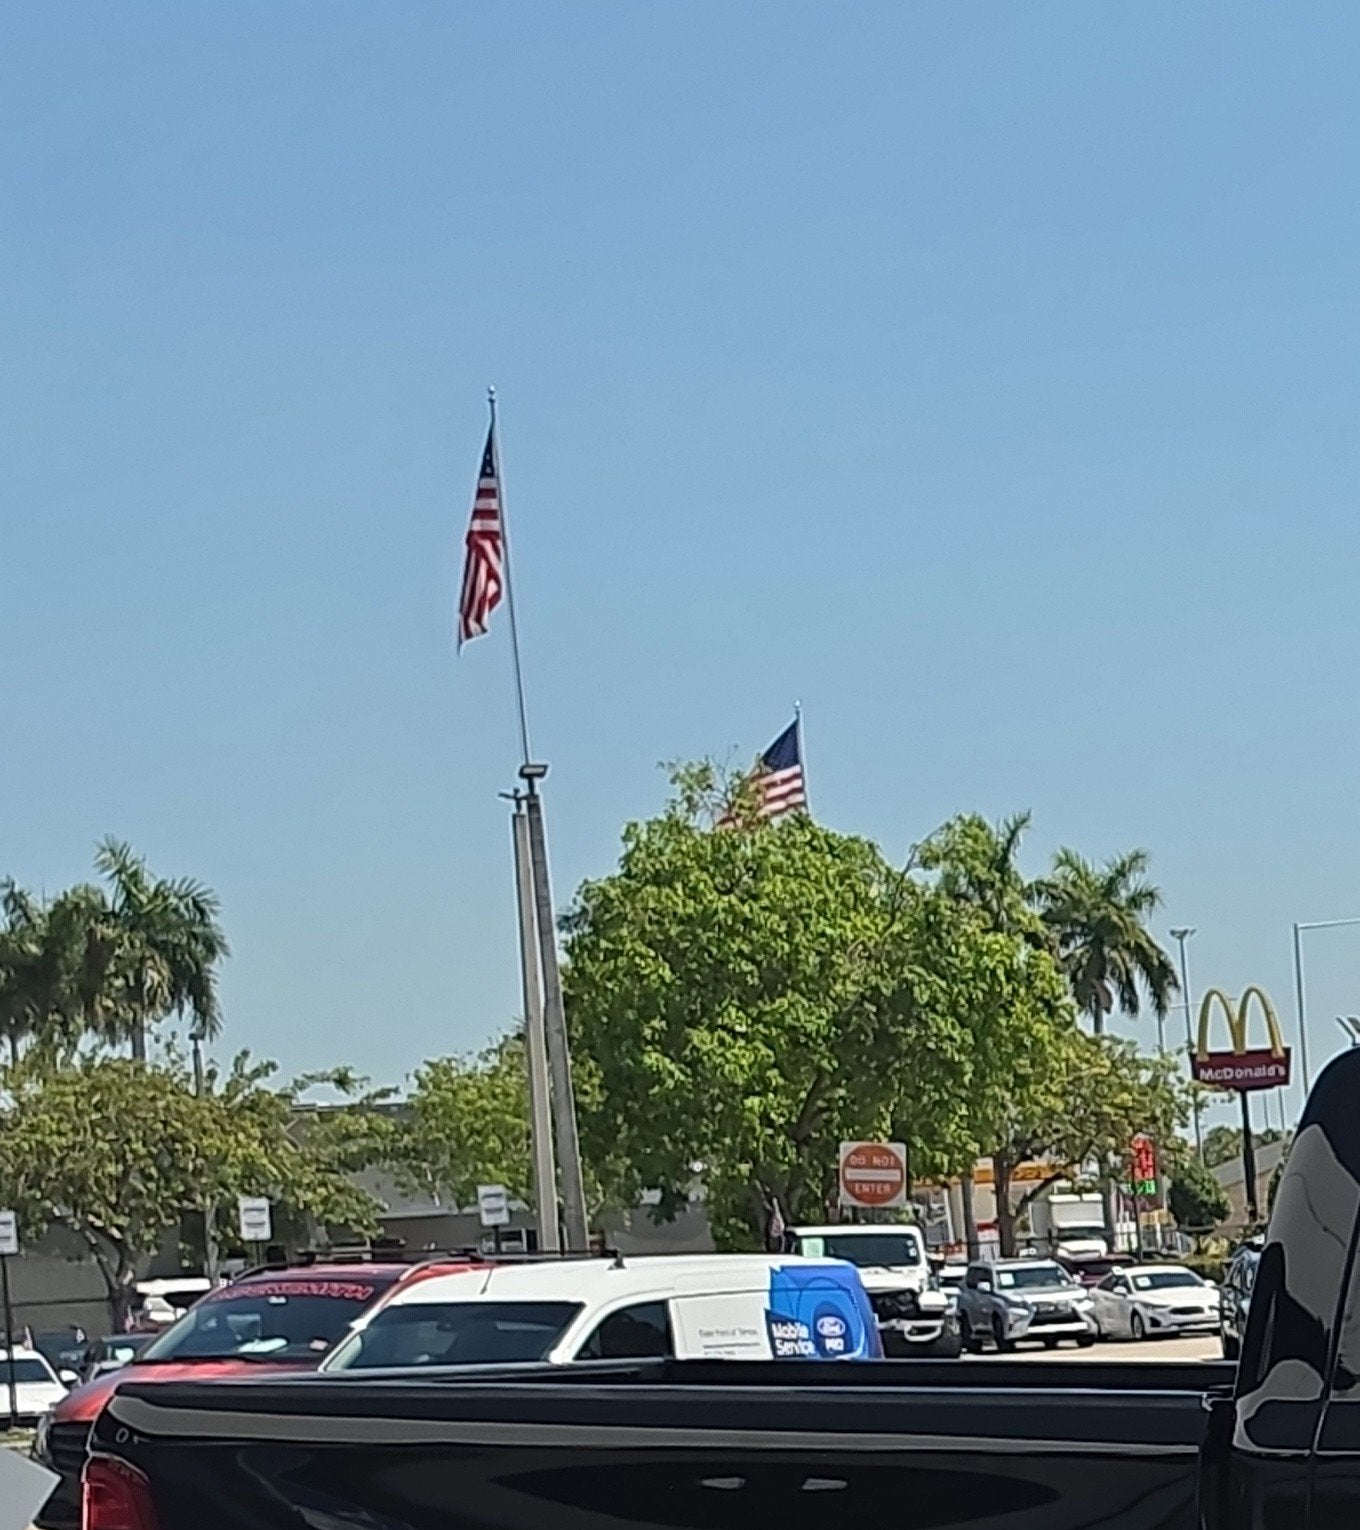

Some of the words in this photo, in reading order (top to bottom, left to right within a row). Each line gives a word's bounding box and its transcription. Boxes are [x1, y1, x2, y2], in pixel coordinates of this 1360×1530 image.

[1200, 1064, 1286, 1080] McDonald's
[850, 1154, 866, 1166] DO
[872, 1155, 895, 1167] NOT
[854, 1183, 891, 1195] ENTER
[772, 1321, 810, 1339] Mobile
[775, 1339, 816, 1356] Service
